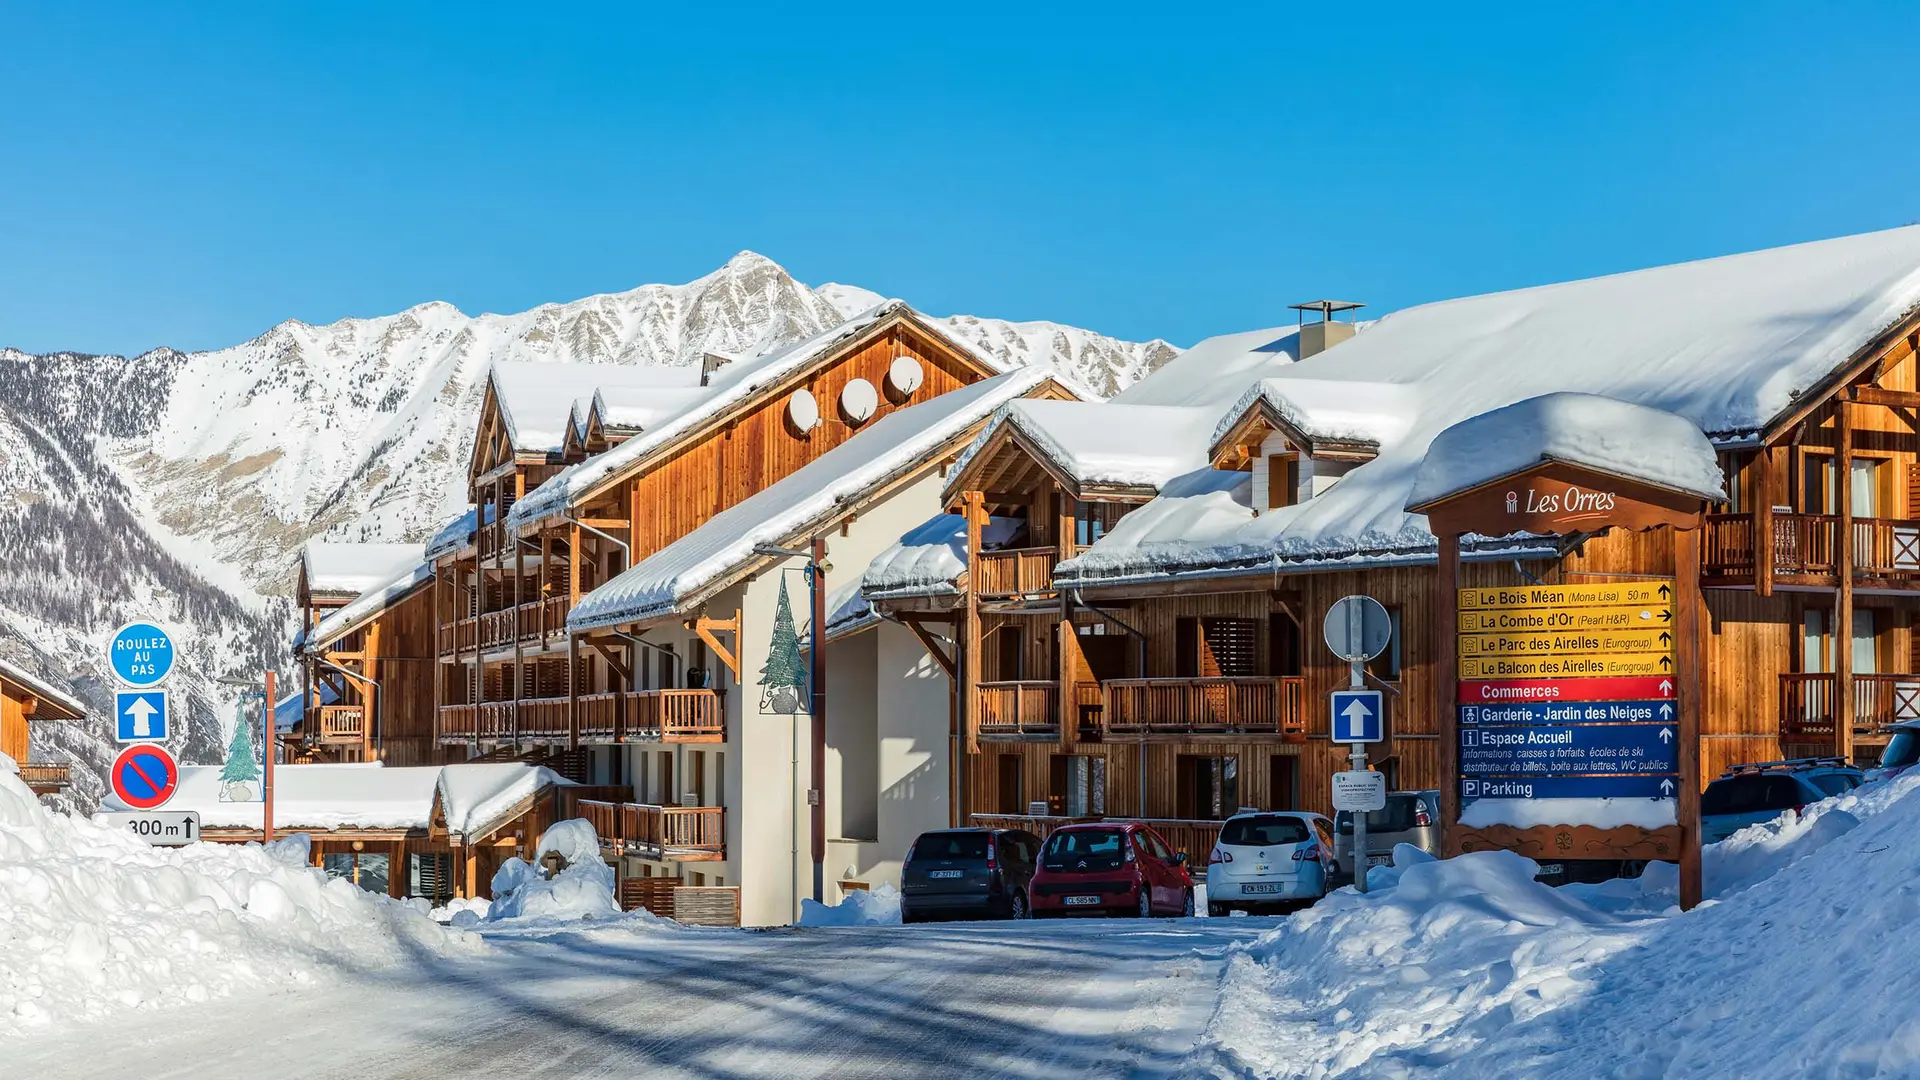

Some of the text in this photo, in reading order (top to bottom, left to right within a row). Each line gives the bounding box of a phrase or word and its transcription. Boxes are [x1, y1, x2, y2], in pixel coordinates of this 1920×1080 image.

[1525, 487, 1616, 513] Les Orres
[1481, 592, 1495, 604] Le
[1500, 591, 1526, 604] Bois
[1532, 590, 1564, 603] Méan
[1568, 592, 1595, 603] (Mona
[1598, 592, 1619, 602] Lisa)
[1628, 590, 1638, 600] 50
[1481, 613, 1630, 628] La Combe d'Or (Pearl H&R)
[117, 638, 166, 650] ROULEZ
[1481, 636, 1652, 651] Le Parc des Airelles (Eurogroup)
[134, 651, 150, 662] AU
[131, 664, 155, 676] PAS
[1482, 660, 1654, 674] Le Balcon des Airelles (Eurogroup)
[1482, 685, 1559, 698] Commerces
[1482, 708, 1532, 721] Garderie
[1543, 707, 1581, 720] Jardin
[1585, 706, 1606, 719] des
[1610, 706, 1652, 722] Neiges
[1482, 730, 1572, 747] Espace Accueil
[1463, 749, 1512, 758] informations
[1516, 750, 1547, 758] caisses
[1556, 748, 1585, 758] forfaits
[1589, 746, 1616, 757] écoles
[1619, 746, 1629, 756] de
[1632, 746, 1643, 756] ski
[1463, 762, 1509, 771] distributeur
[1510, 762, 1520, 771] de
[1522, 762, 1548, 772] billets,
[1590, 761, 1618, 772] lettres,
[1621, 760, 1636, 769] WC
[1638, 760, 1668, 772] publics
[1483, 782, 1532, 797] Parking
[129, 820, 178, 835] 300 m
